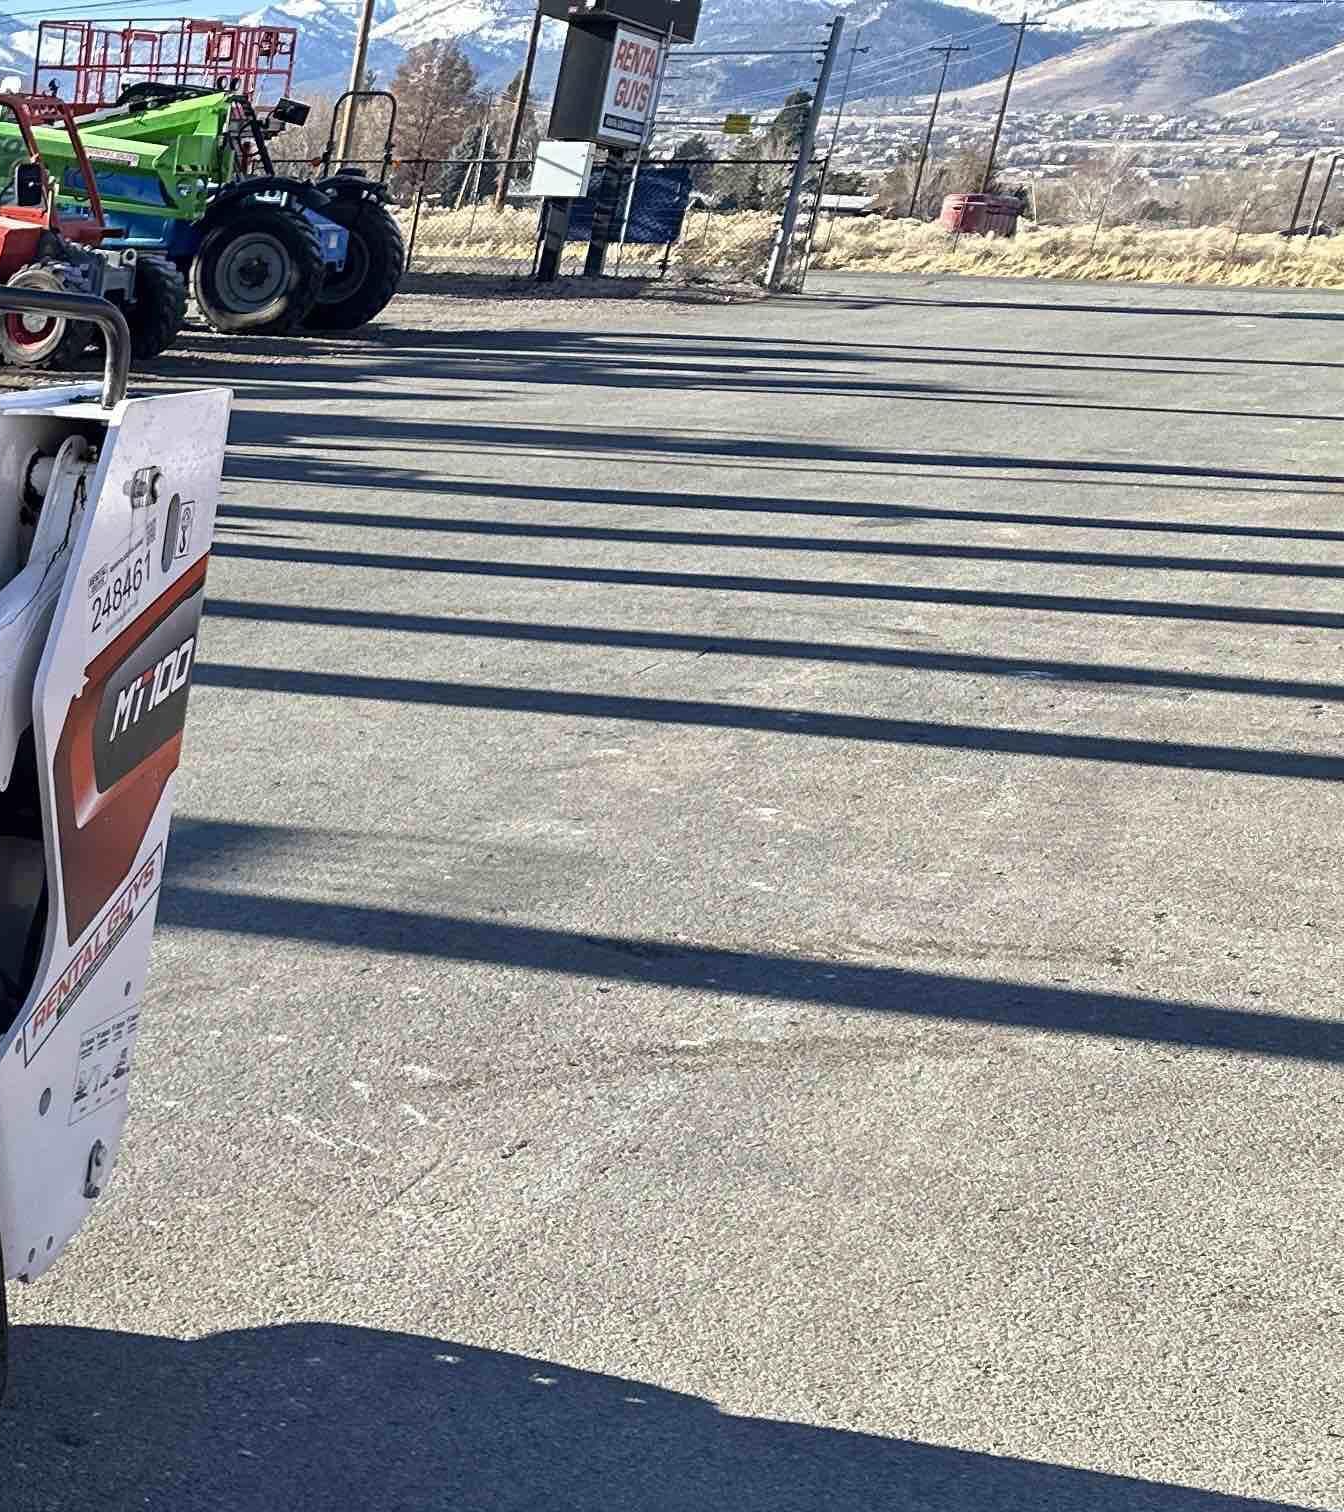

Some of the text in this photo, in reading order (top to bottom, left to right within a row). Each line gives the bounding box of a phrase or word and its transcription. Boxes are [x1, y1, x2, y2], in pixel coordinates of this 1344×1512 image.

[614, 39, 659, 79] RENTA
[614, 77, 649, 112] GUYS
[92, 549, 151, 632] 248461
[31, 931, 103, 1039] RENTAL
[106, 859, 156, 937] GUYS
